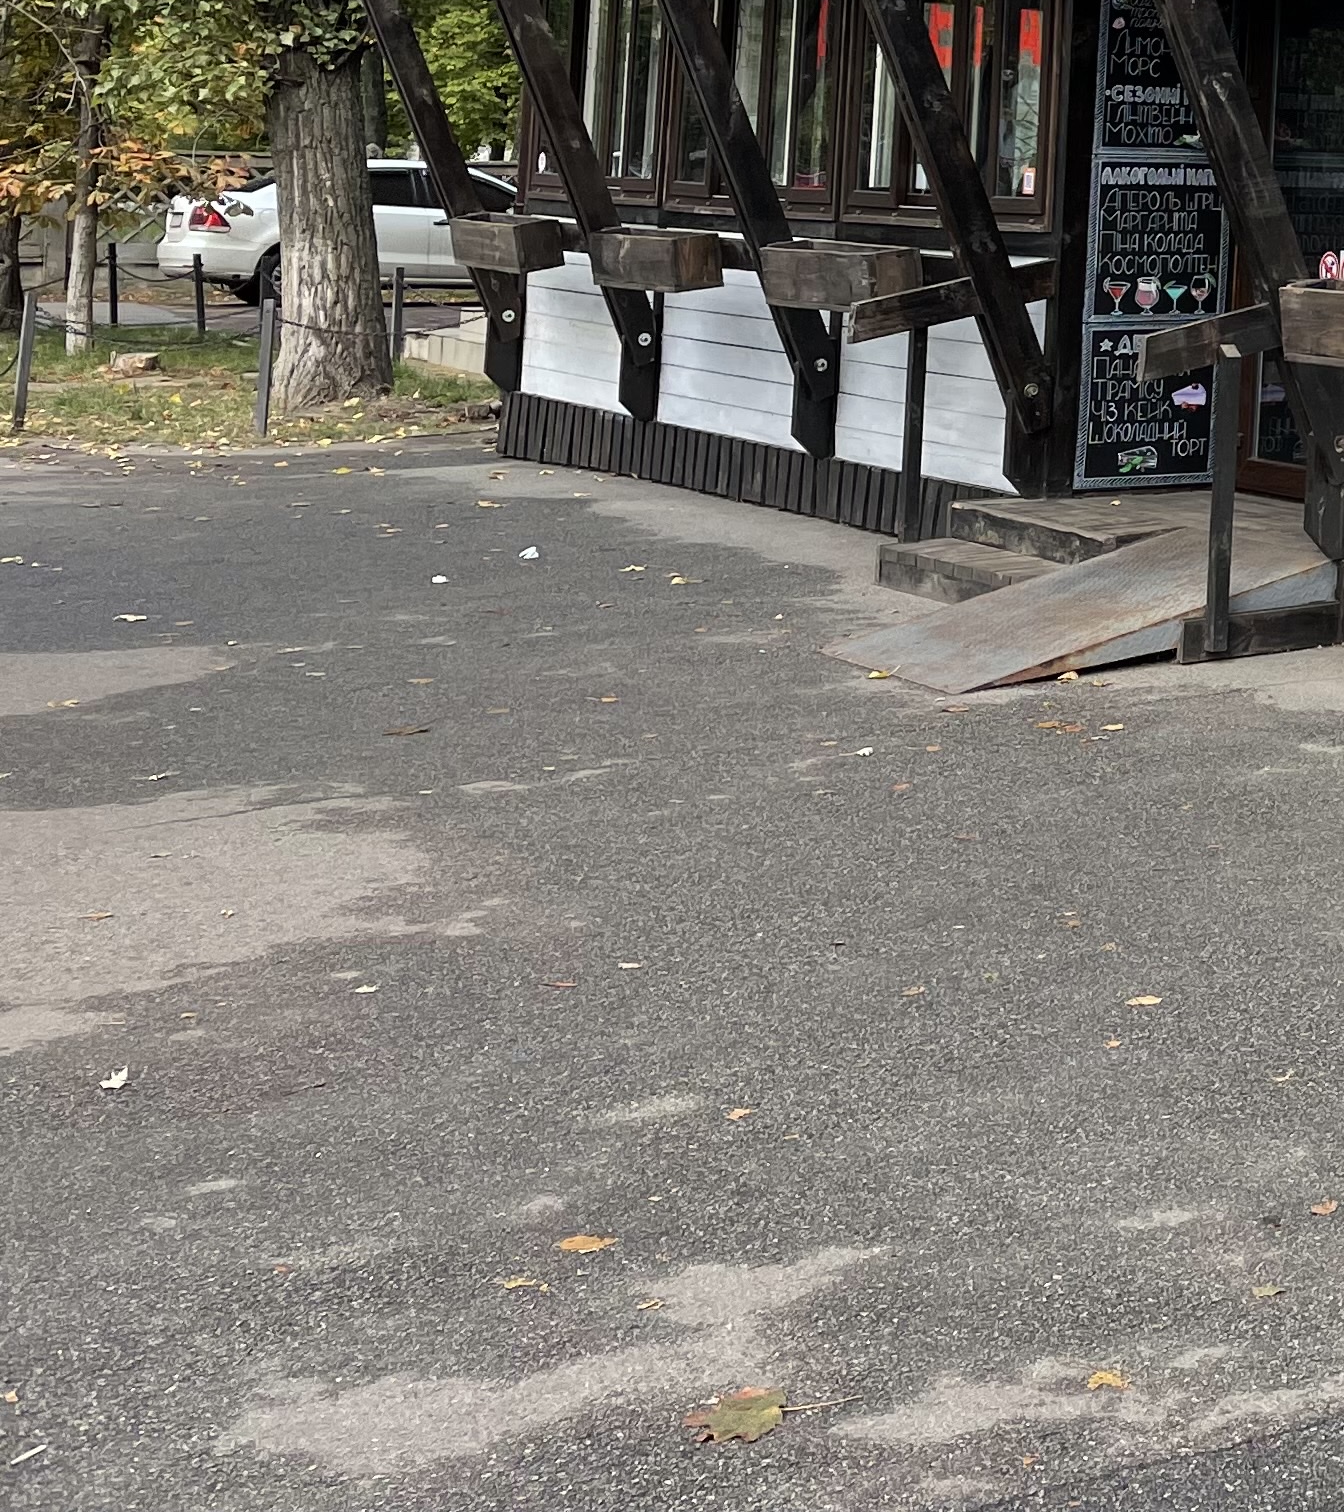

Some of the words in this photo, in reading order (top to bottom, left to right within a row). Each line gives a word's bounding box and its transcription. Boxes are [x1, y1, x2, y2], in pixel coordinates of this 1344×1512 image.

[1110, 54, 1161, 78] МОРС
[1111, 82, 1181, 104] СЕЗОННІ
[1104, 122, 1174, 145] МОХІТО
[1101, 163, 1185, 186] АЛКОГОЛЬНІ
[1101, 187, 1181, 210] АПЕРОЛЬ
[1100, 210, 1198, 231] МАРГАРИТА
[1099, 231, 1140, 252] ПІНА
[1143, 232, 1205, 253] КОЛАДА
[1098, 252, 1219, 276] КОСМОПОЛІТЕН
[1092, 378, 1165, 401] ТІРАМІСУ
[1091, 400, 1118, 422] ЧІЗ
[1124, 398, 1173, 421] КЕЙК
[1088, 419, 1188, 445] ШОКОЛАДНИЙ
[1170, 438, 1208, 457] ТОРТ
